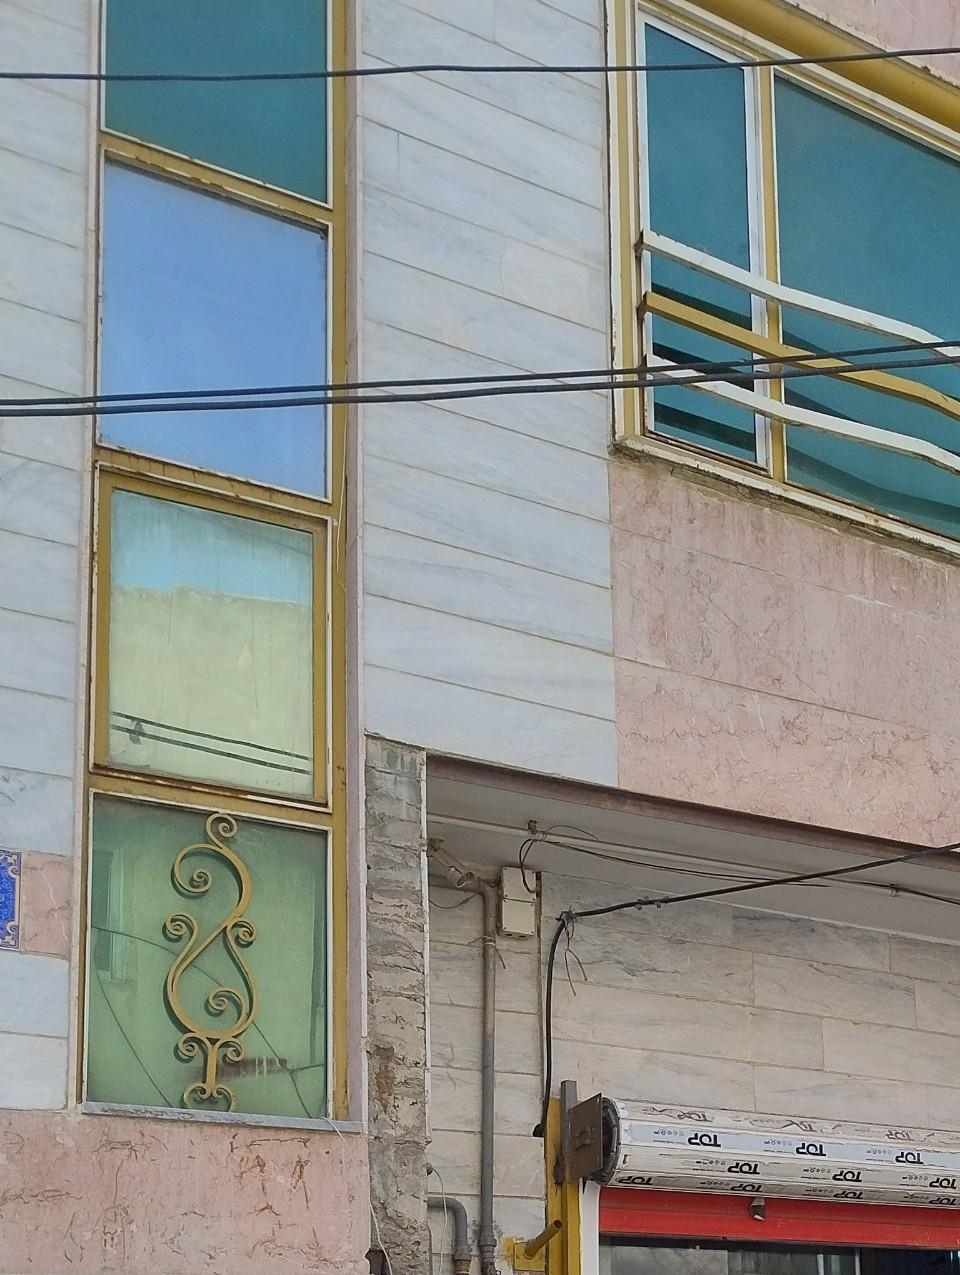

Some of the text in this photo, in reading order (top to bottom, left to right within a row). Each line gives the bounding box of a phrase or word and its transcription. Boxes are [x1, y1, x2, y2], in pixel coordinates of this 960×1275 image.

[687, 1132, 721, 1148] TOP
[795, 1142, 826, 1157] TOP
[895, 1151, 924, 1165] TOP
[727, 1161, 760, 1175] TOP
[618, 1175, 653, 1186] TOP
[832, 1169, 862, 1183] TOP
[730, 1182, 763, 1193] TOP
[929, 1177, 957, 1190] TOP
[833, 1189, 863, 1199] TOP
[928, 1196, 957, 1206] TOP
